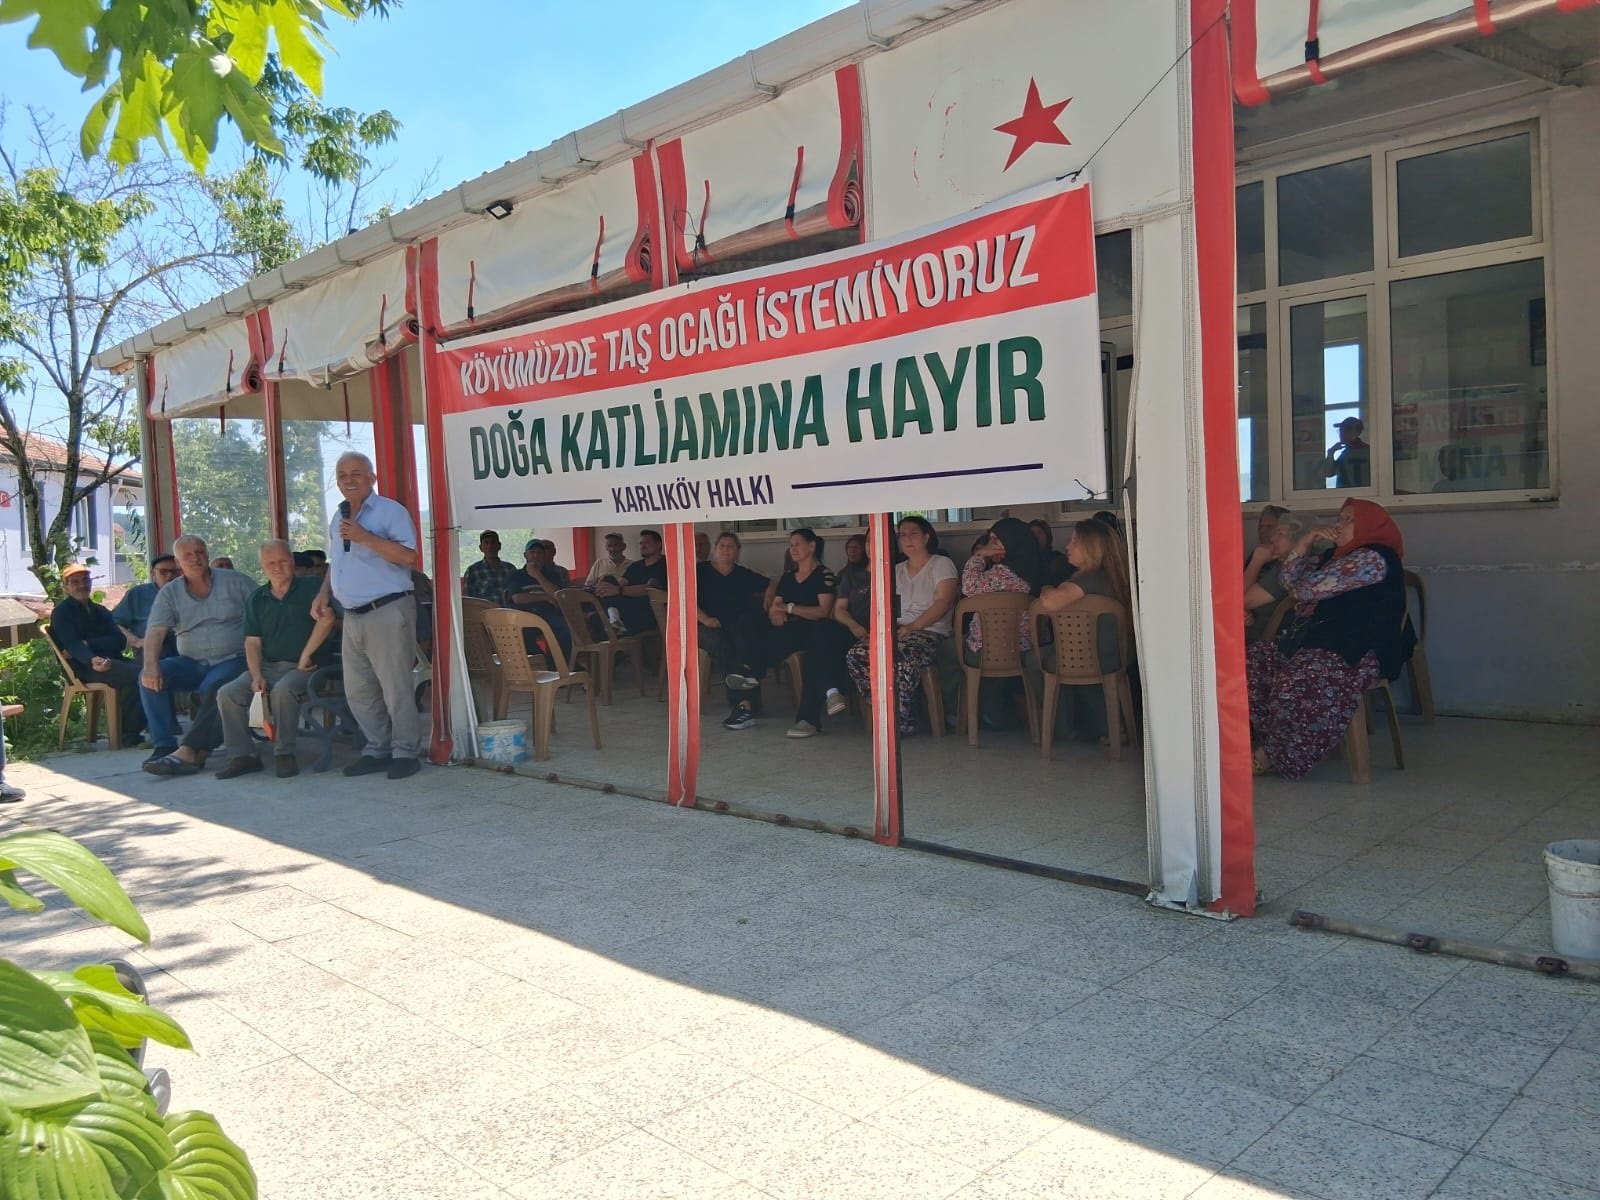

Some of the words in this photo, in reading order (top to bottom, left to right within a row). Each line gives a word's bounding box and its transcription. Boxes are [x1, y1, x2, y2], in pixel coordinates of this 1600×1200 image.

[460, 337, 597, 397] KÖYÜMÜZDE
[602, 323, 652, 374] TAŞ
[659, 292, 747, 362] OCAĞI
[755, 225, 1039, 342] İSTEMİYORUZ
[469, 408, 553, 480] DOĞA
[560, 375, 829, 473] KATLİAMINA
[846, 336, 1046, 443] HAYIR
[611, 477, 701, 513] KARLIKÖY
[707, 475, 774, 508] HALKI
